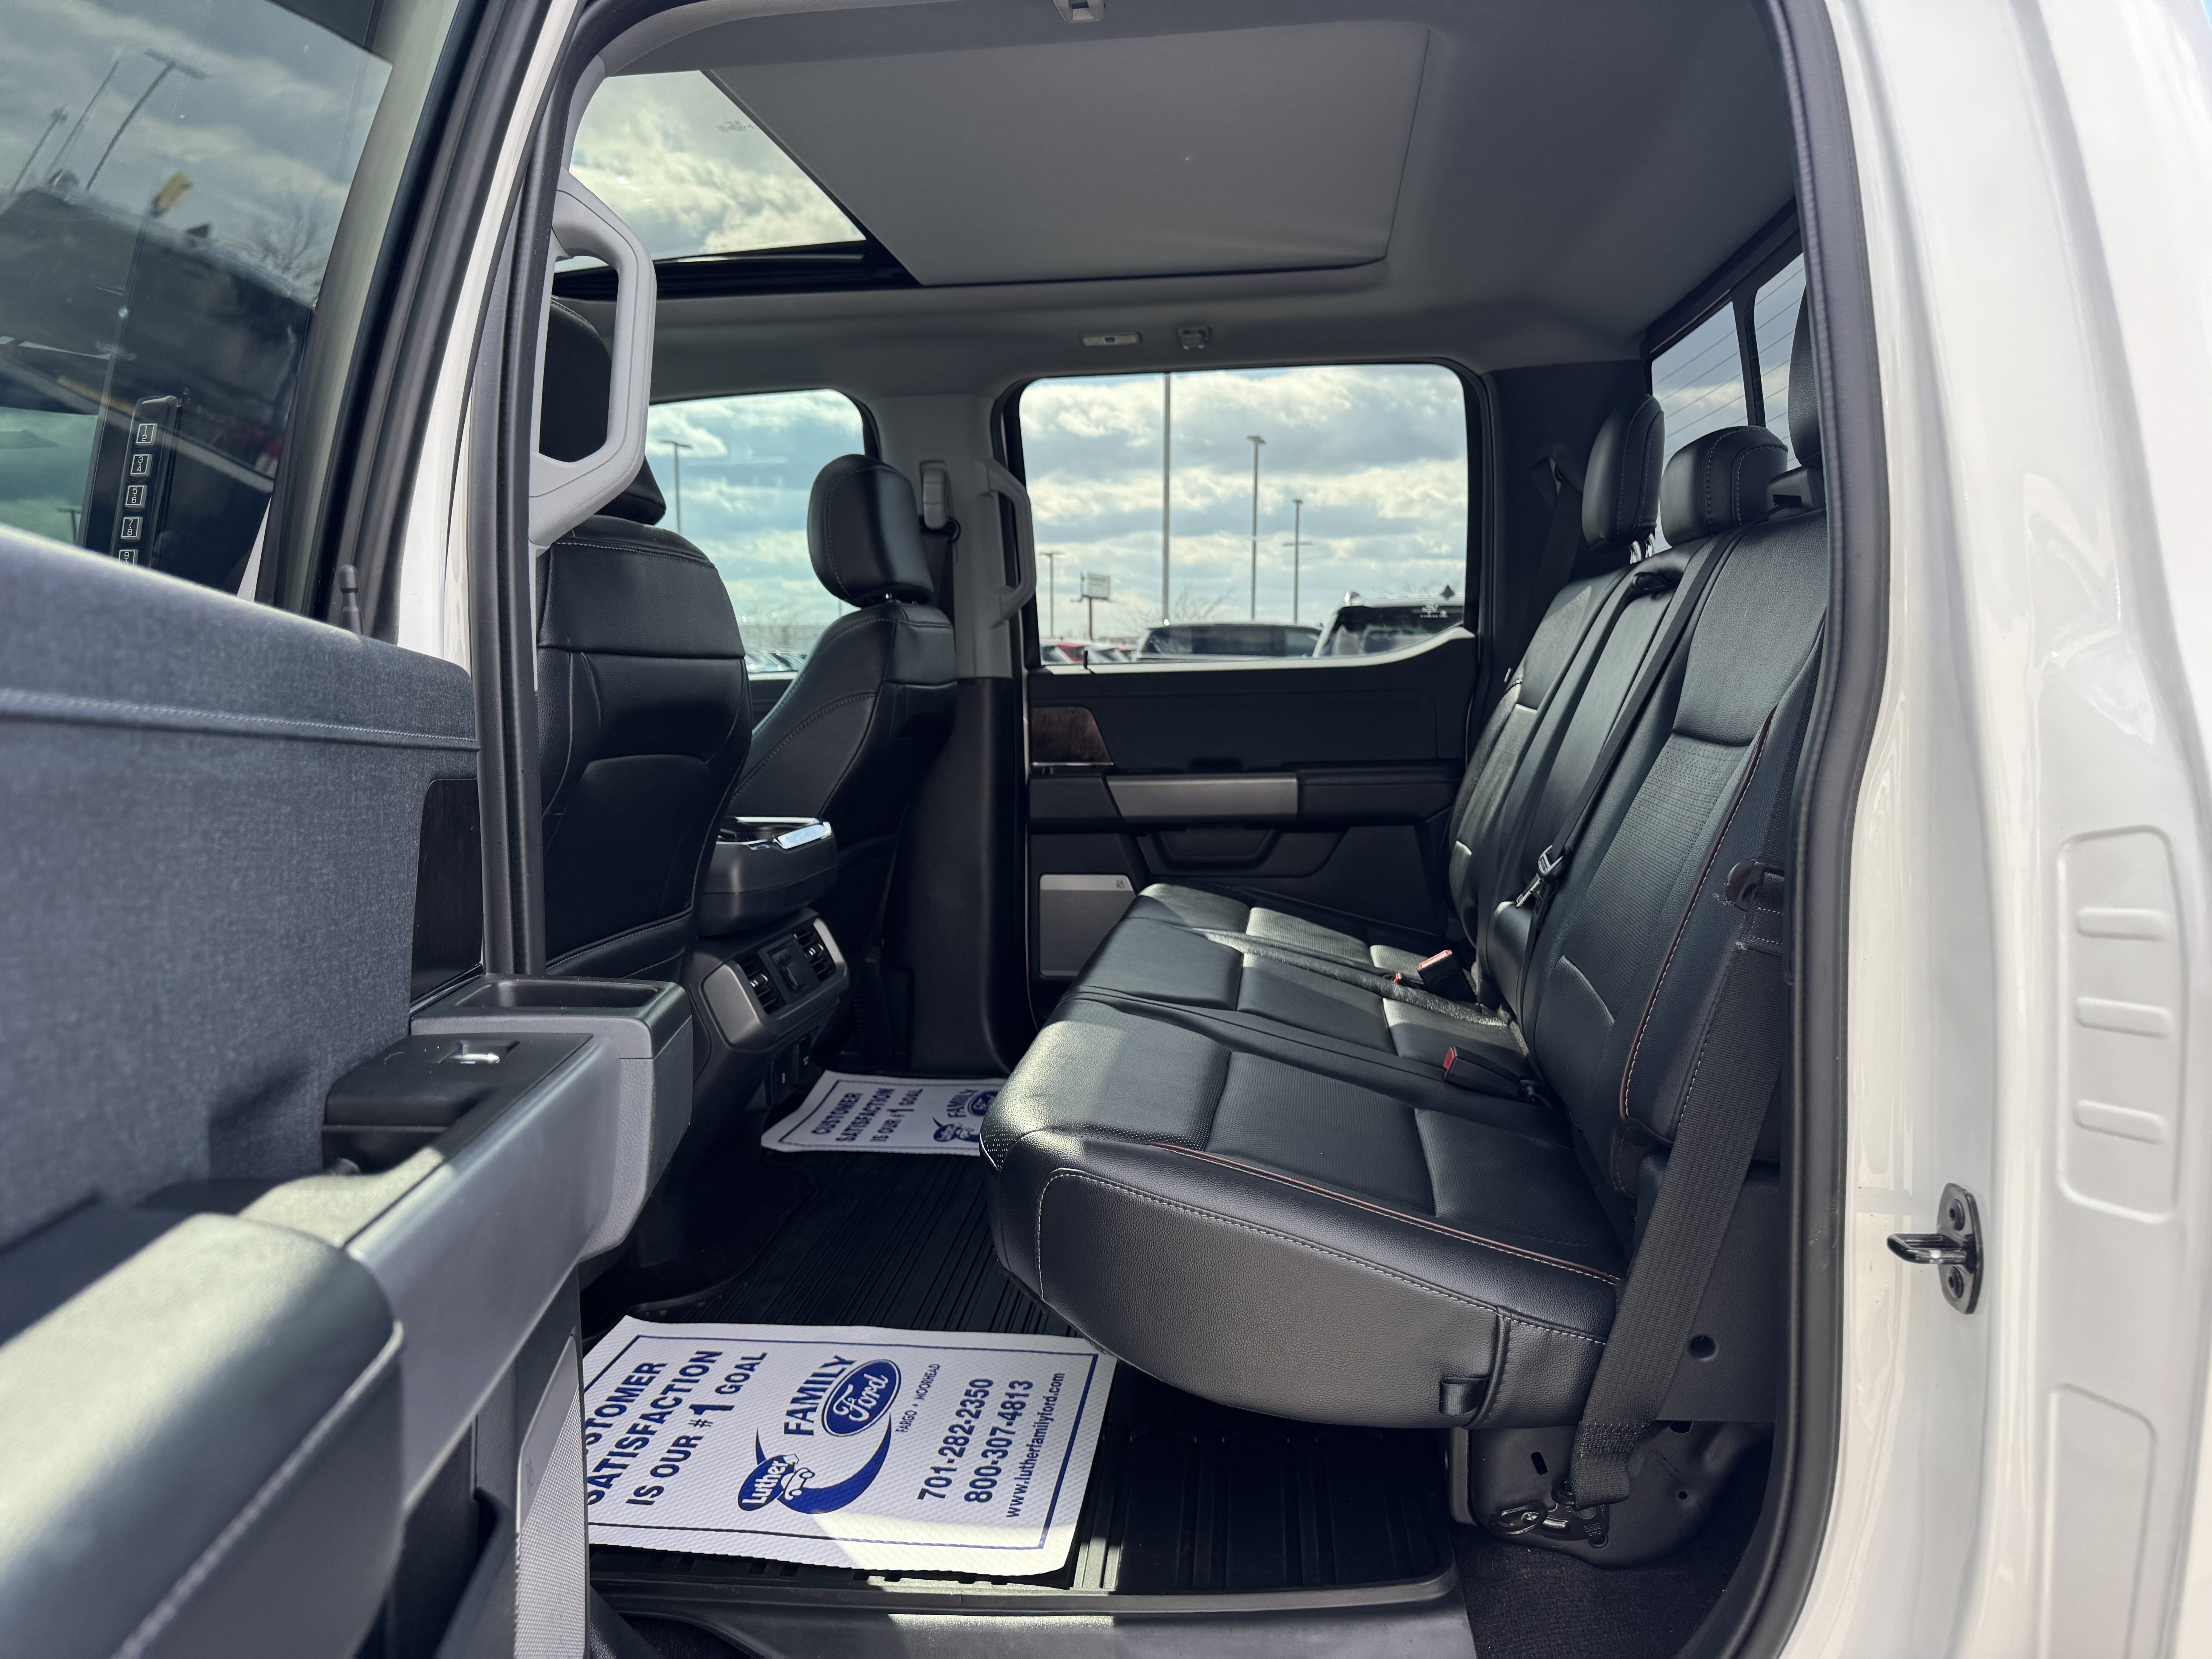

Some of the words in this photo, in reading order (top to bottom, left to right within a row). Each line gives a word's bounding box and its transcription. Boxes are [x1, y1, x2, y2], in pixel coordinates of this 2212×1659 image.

[811, 1092, 863, 1135] CUSTOMER
[835, 1087, 895, 1142] SATISFACTION
[877, 1119, 902, 1133] OUR
[898, 1088, 923, 1106] GOAL
[946, 1088, 979, 1118] FAMILY
[585, 1362, 668, 1455] TOMER
[625, 1485, 665, 1506] IS
[649, 1435, 704, 1478] OUR
[714, 1352, 768, 1395] GOAL
[784, 1354, 857, 1436] FAMILY
[832, 1373, 890, 1422] Ford
[895, 1410, 917, 1432] FARGO
[913, 1363, 940, 1400] MOORHEAD
[916, 1378, 994, 1500] 701-282-2350
[963, 1380, 1033, 1503] 800-307-4813
[1006, 1372, 1065, 1518] www.lutherfamilyford.com
[742, 1460, 789, 1504] Luther
